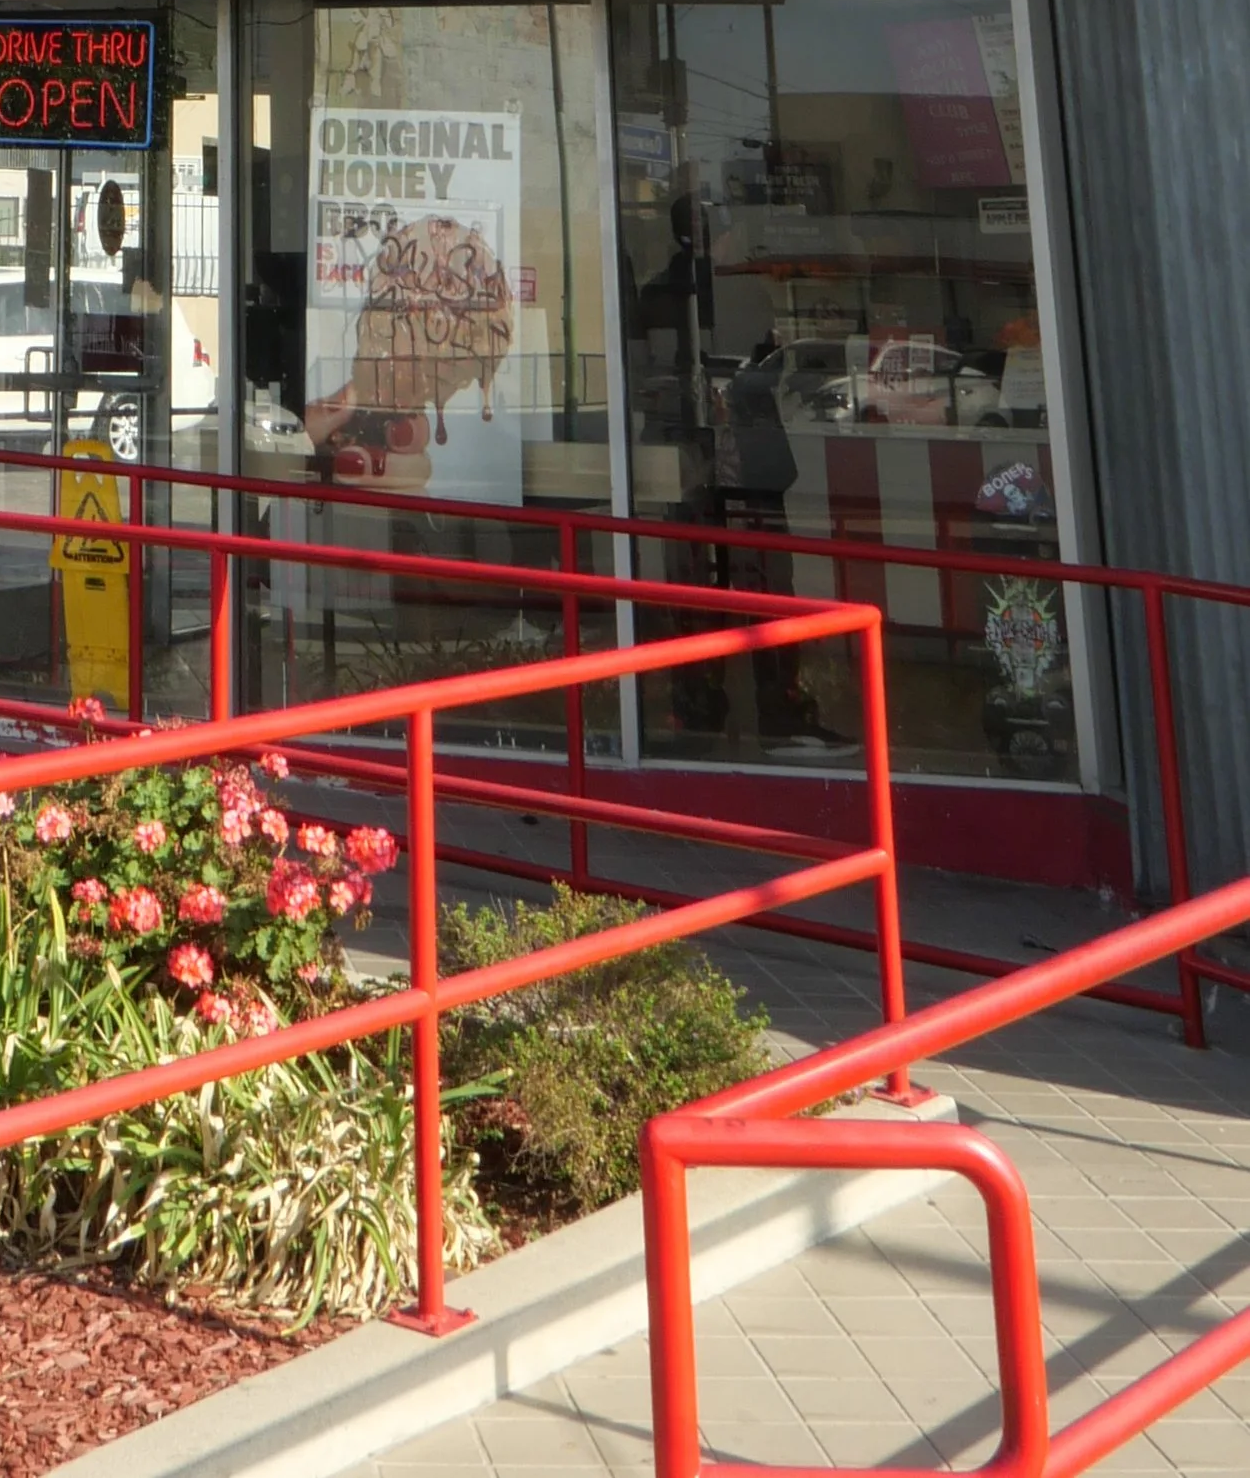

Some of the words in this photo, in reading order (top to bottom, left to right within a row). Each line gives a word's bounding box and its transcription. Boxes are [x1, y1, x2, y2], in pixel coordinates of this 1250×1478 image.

[71, 30, 146, 67] THRU
[318, 116, 513, 161] ORIGINAL
[317, 159, 456, 200] HONEY
